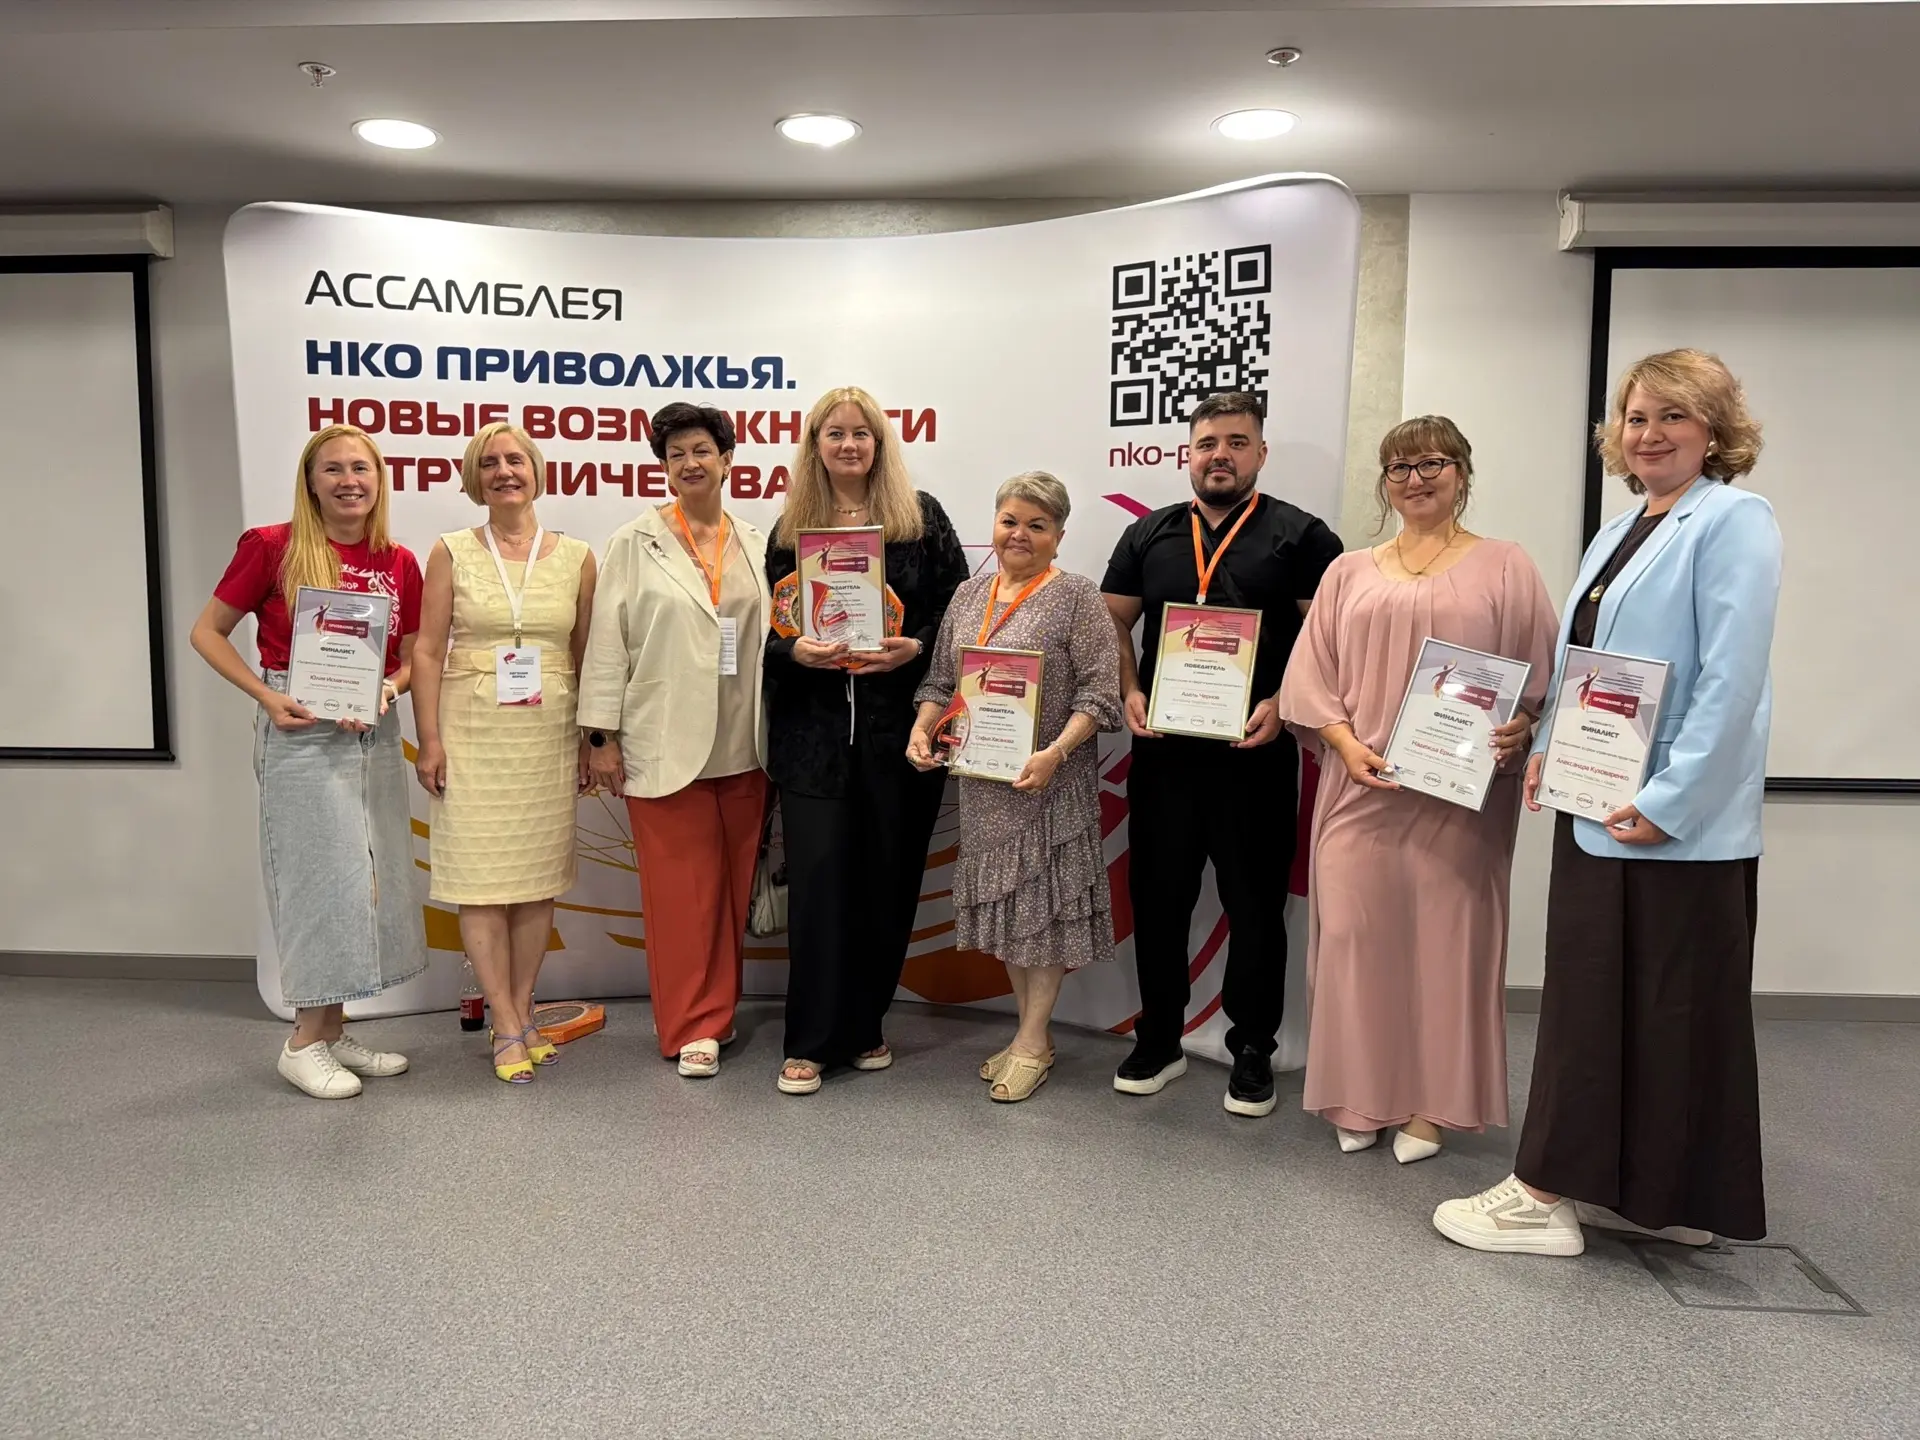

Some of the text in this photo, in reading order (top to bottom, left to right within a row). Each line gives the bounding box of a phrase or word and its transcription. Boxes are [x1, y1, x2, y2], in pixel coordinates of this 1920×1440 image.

[304, 269, 623, 321] АССАМБЛЕЯ
[305, 339, 796, 391] НКО ПРИВОЛЖЬЯ.
[320, 646, 355, 655] ФИНАЛИСТ
[1184, 663, 1226, 672] ПОБЕДИТЕЛЬ
[979, 706, 1014, 714] ПОБЕДИТЕЛЬ
[1433, 711, 1474, 727] ФИНАЛИСТ
[1580, 725, 1620, 739] ФИНАЛИСТ
[1556, 757, 1590, 771] Александра
